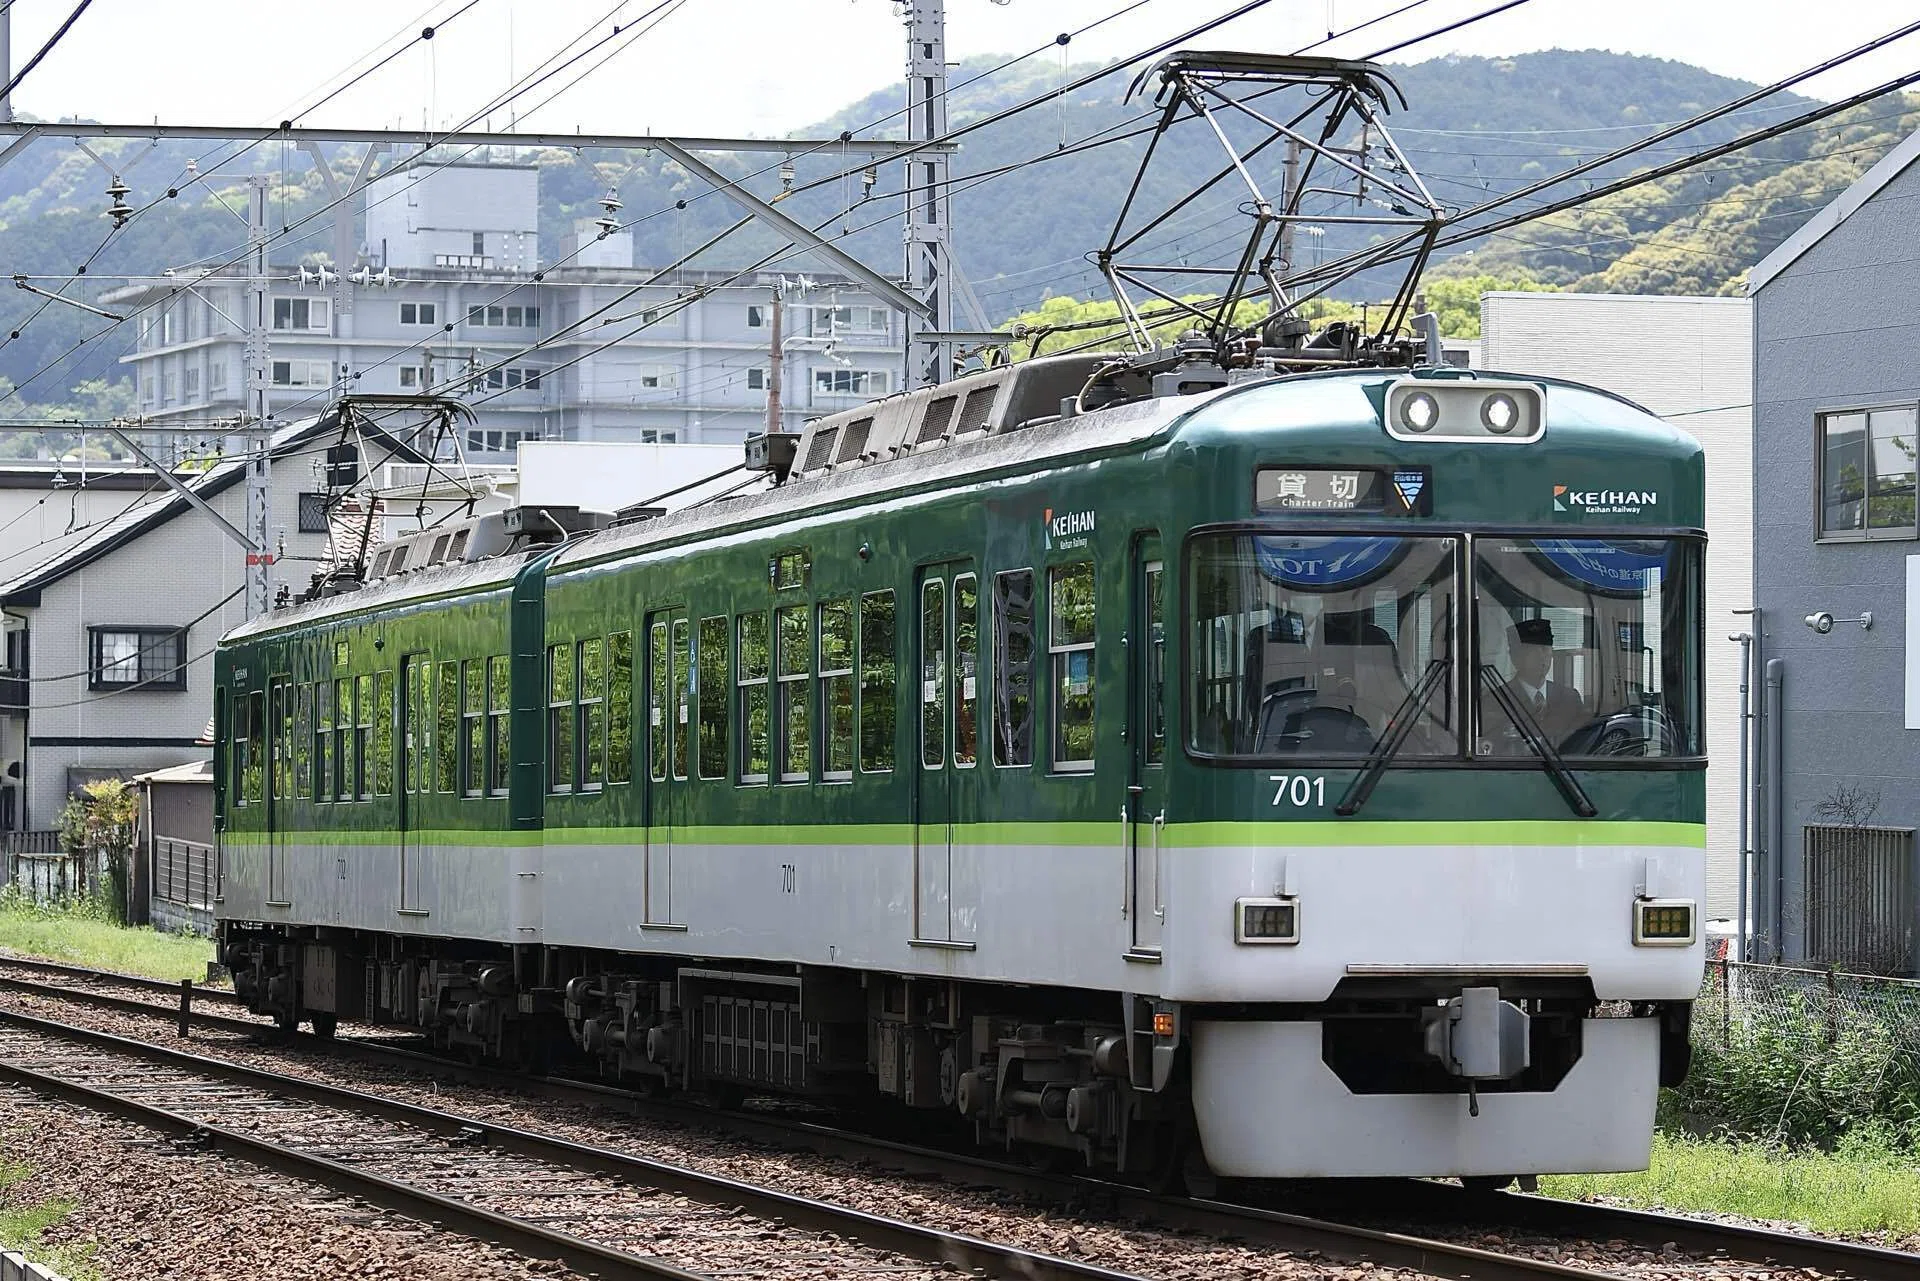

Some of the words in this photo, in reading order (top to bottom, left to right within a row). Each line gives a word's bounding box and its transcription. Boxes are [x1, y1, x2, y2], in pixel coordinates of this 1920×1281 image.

[1277, 473, 1359, 499] 貸切
[1569, 489, 1657, 505] KEIHAN
[1282, 498, 1322, 508] Charter
[1326, 499, 1354, 509] Train
[1585, 506, 1611, 514] Keihan
[1612, 506, 1641, 515] Railway
[1053, 510, 1095, 537] KEIHAN
[1269, 775, 1325, 807] 701
[782, 864, 796, 893] 701
